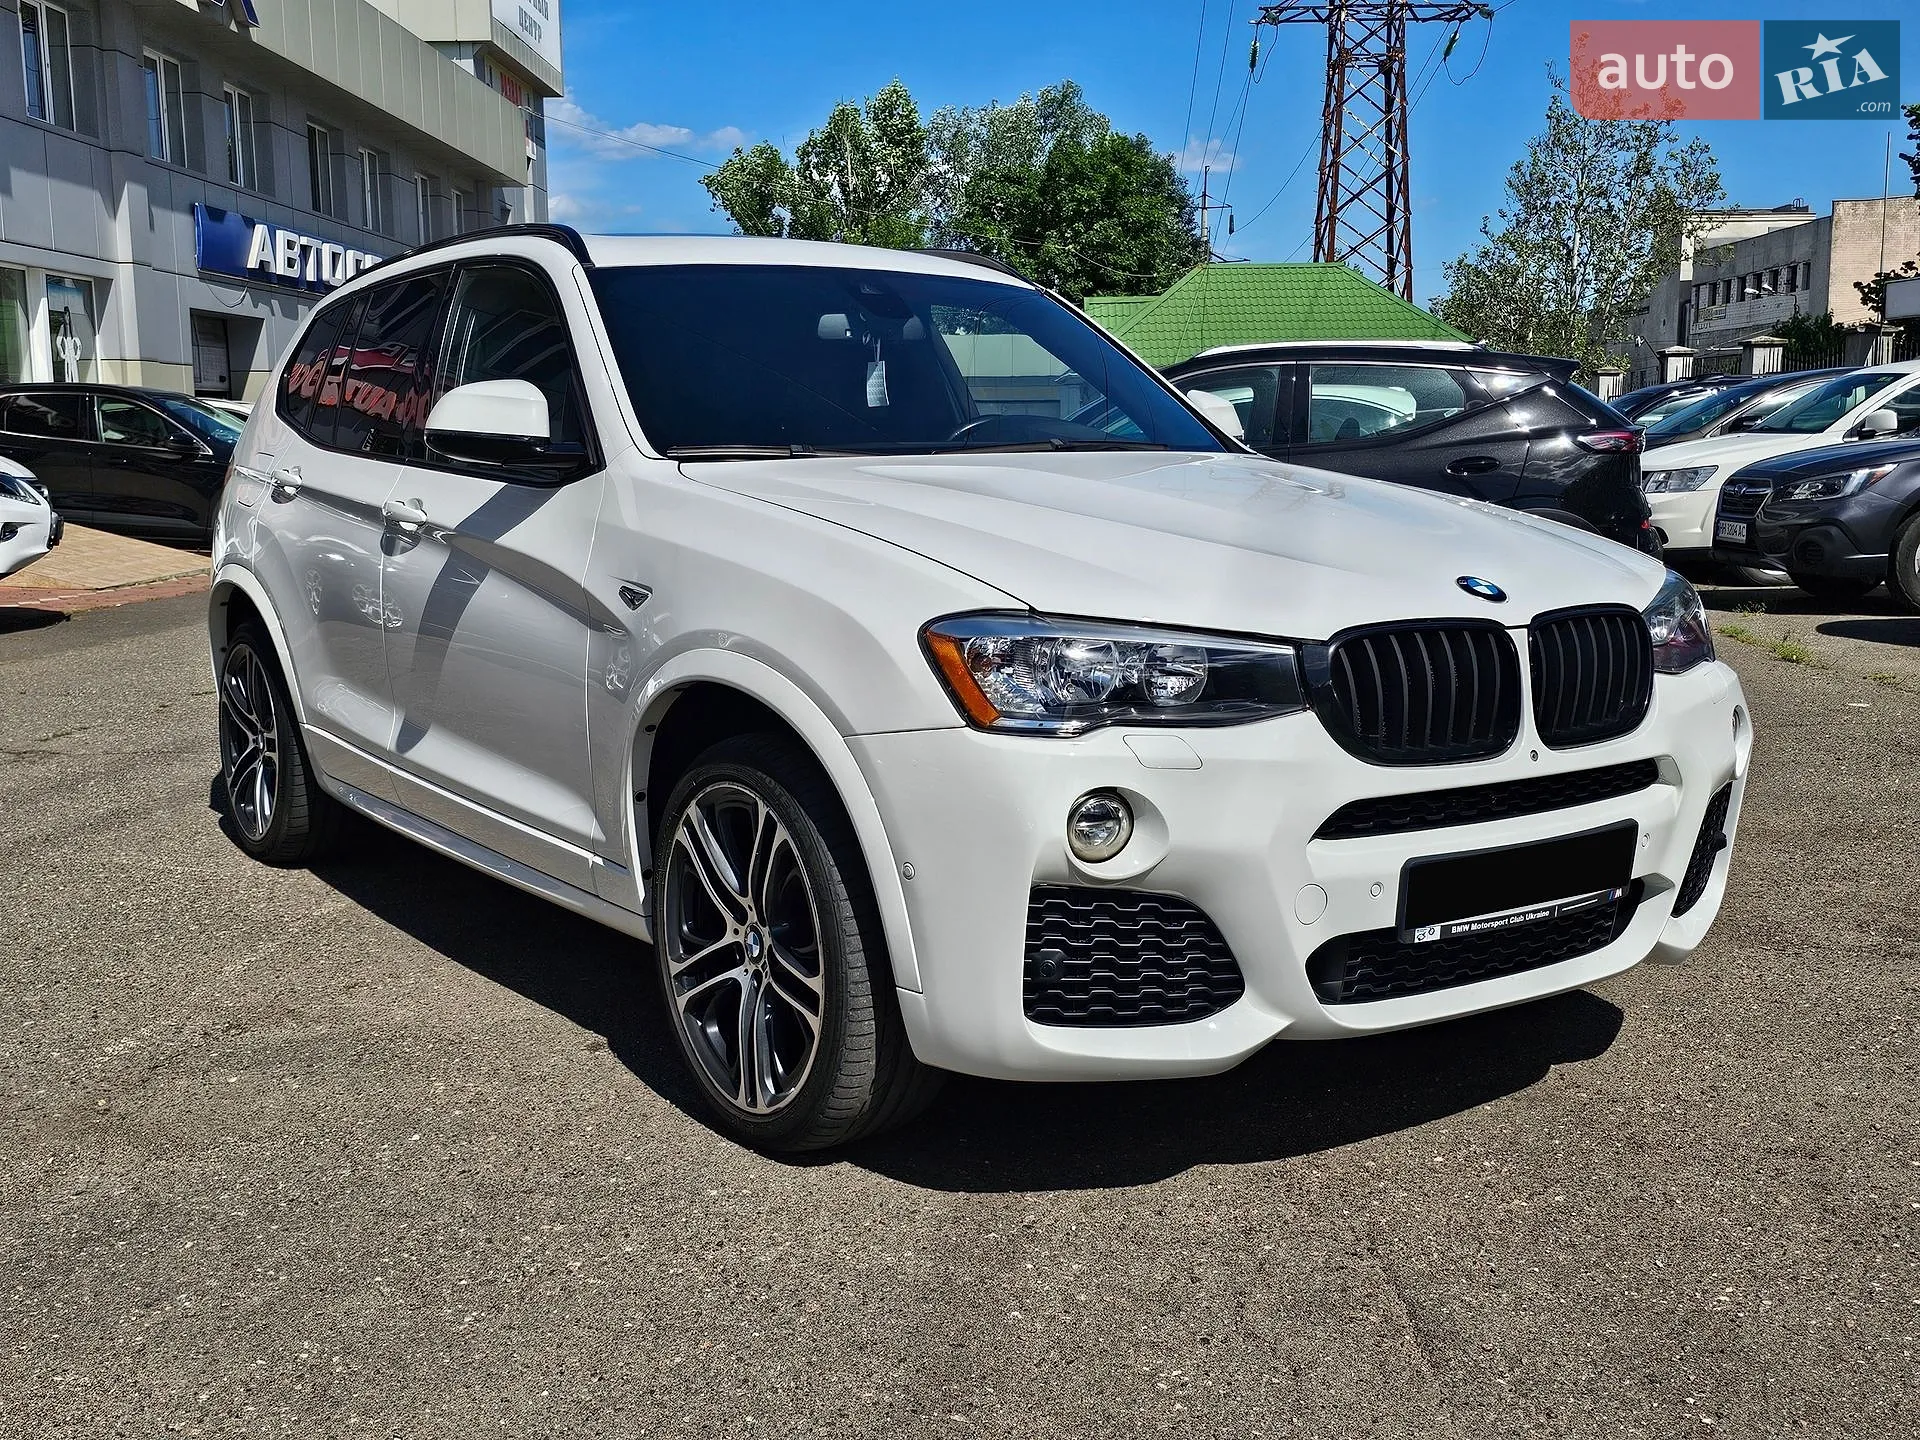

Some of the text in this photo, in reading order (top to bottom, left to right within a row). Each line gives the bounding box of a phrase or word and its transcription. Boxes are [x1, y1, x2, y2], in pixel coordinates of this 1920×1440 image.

[518, 5, 542, 43] ЦЕНТР
[1451, 923, 1470, 934] BMW
[1471, 918, 1508, 931] Motorsport
[1509, 915, 1524, 924] Club
[1525, 910, 1550, 921] Ukraine
